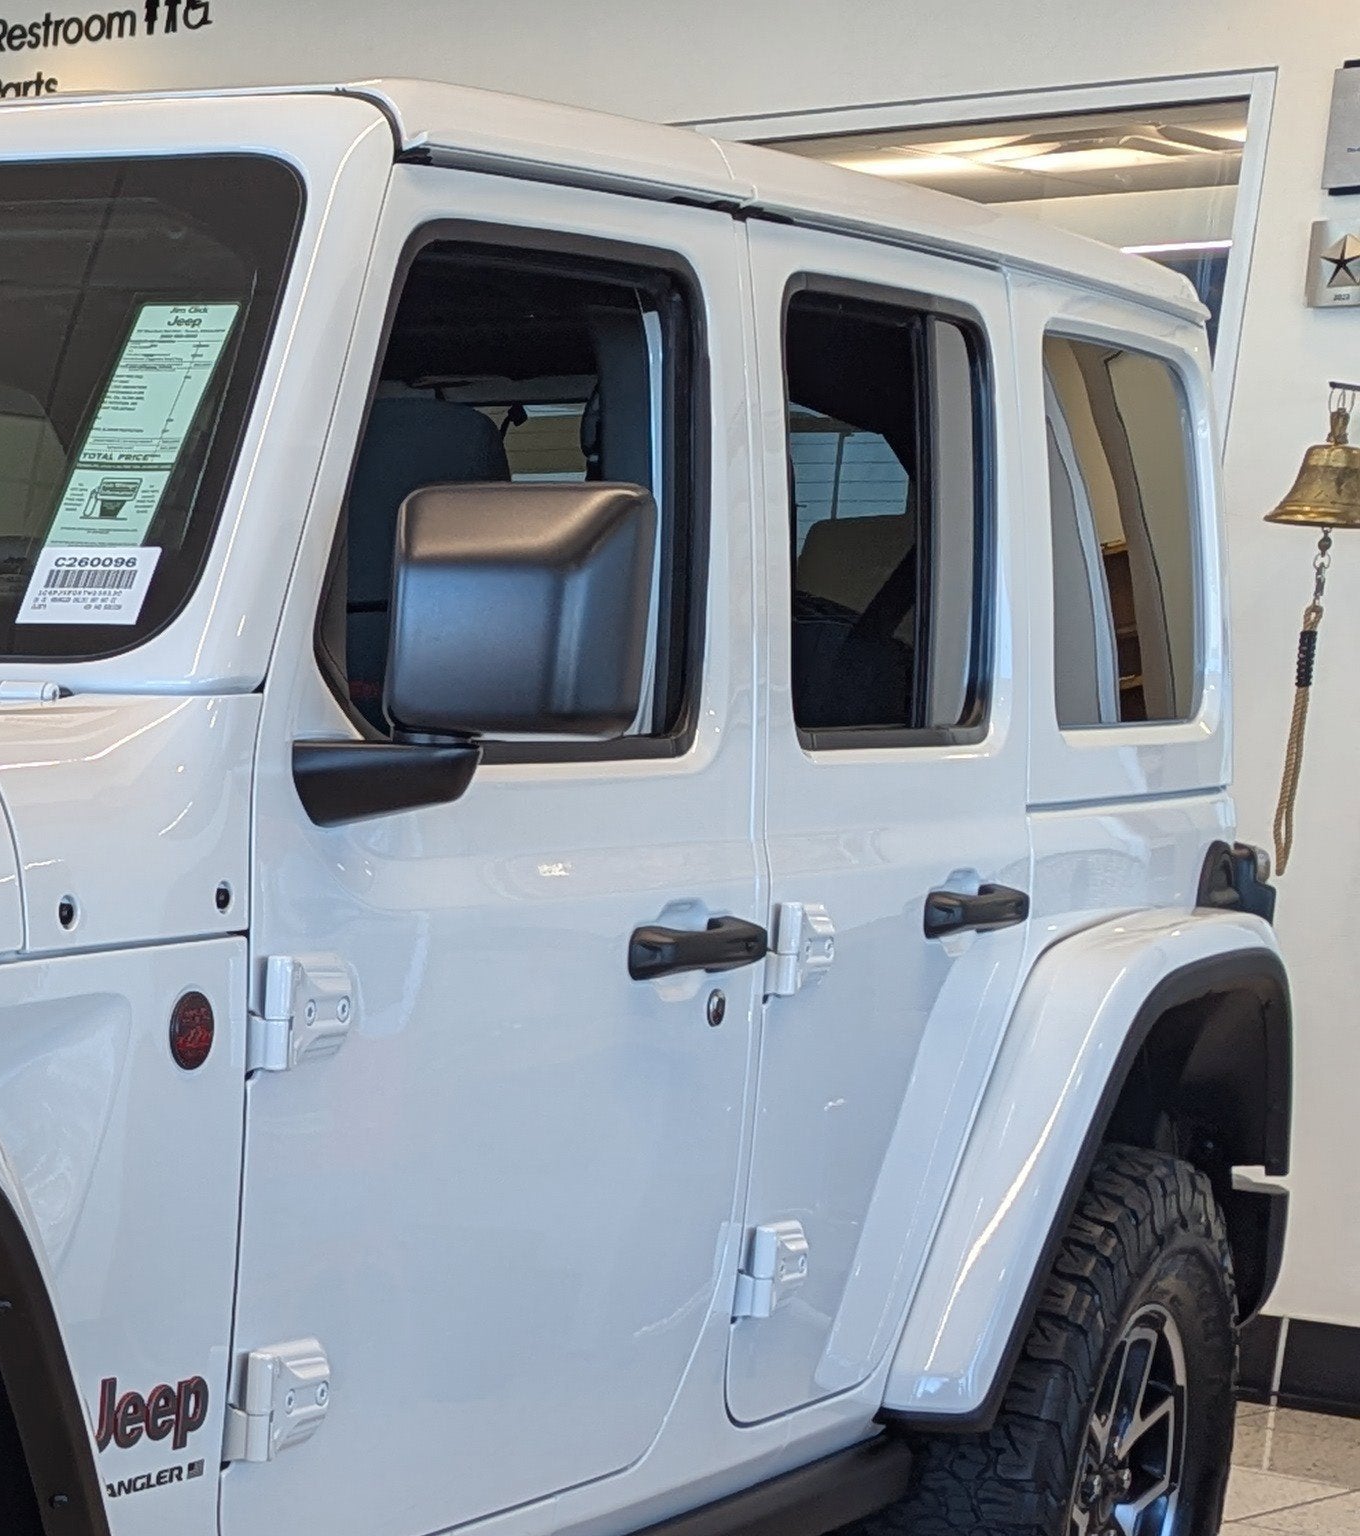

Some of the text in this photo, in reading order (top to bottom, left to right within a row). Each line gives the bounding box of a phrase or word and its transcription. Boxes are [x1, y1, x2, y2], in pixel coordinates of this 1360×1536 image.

[167, 315, 203, 328] Jeep
[81, 452, 150, 462] TOTAL PRICE
[54, 557, 138, 568] C260096
[95, 1375, 210, 1454] Jeep
[105, 1465, 184, 1498] ANGLER
